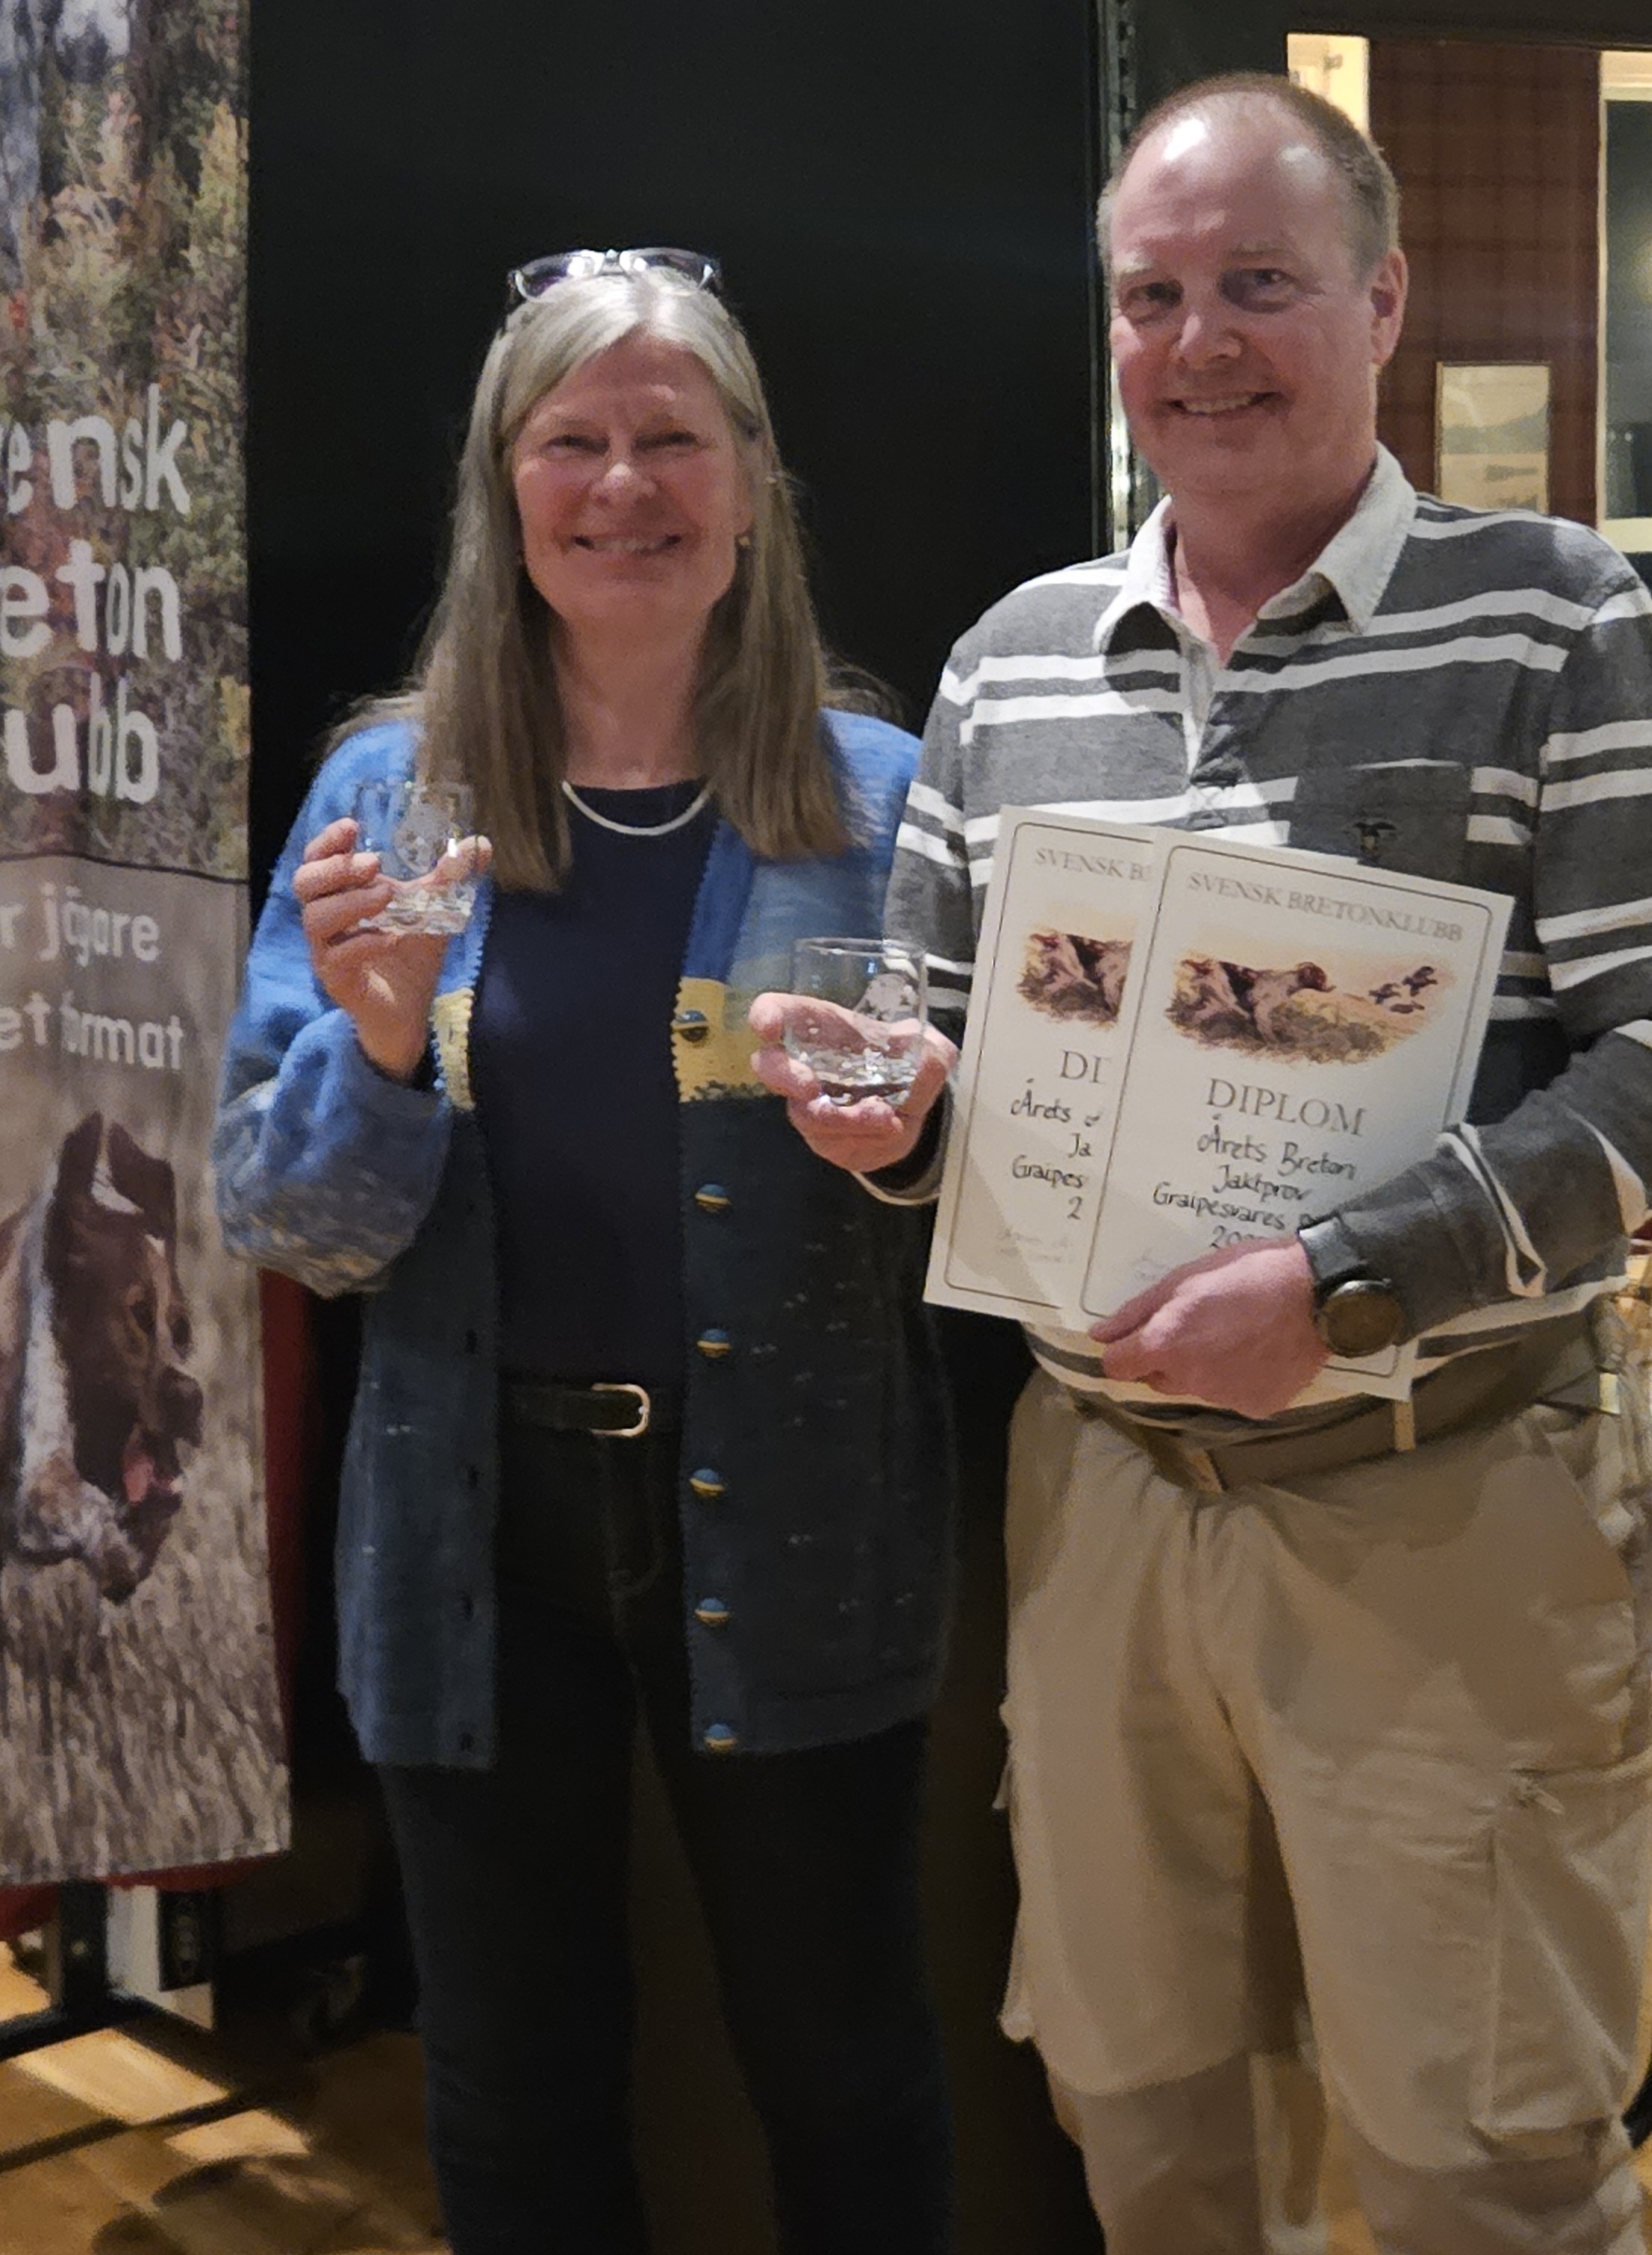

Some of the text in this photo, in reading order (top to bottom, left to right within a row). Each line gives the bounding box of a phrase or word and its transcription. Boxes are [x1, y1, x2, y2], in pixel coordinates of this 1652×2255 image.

[1035, 847, 1125, 879] SVENSK
[1188, 872, 1464, 941] SVENSK BRETONKLUBB
[1059, 1049, 1110, 1085] DI
[1011, 1078, 1071, 1123] Årets
[1206, 1078, 1367, 1137] DIPLOM
[1197, 1113, 1357, 1180] Årets Breton
[1212, 1164, 1315, 1202] Jaktprov
[1067, 1195, 1083, 1220] 2
